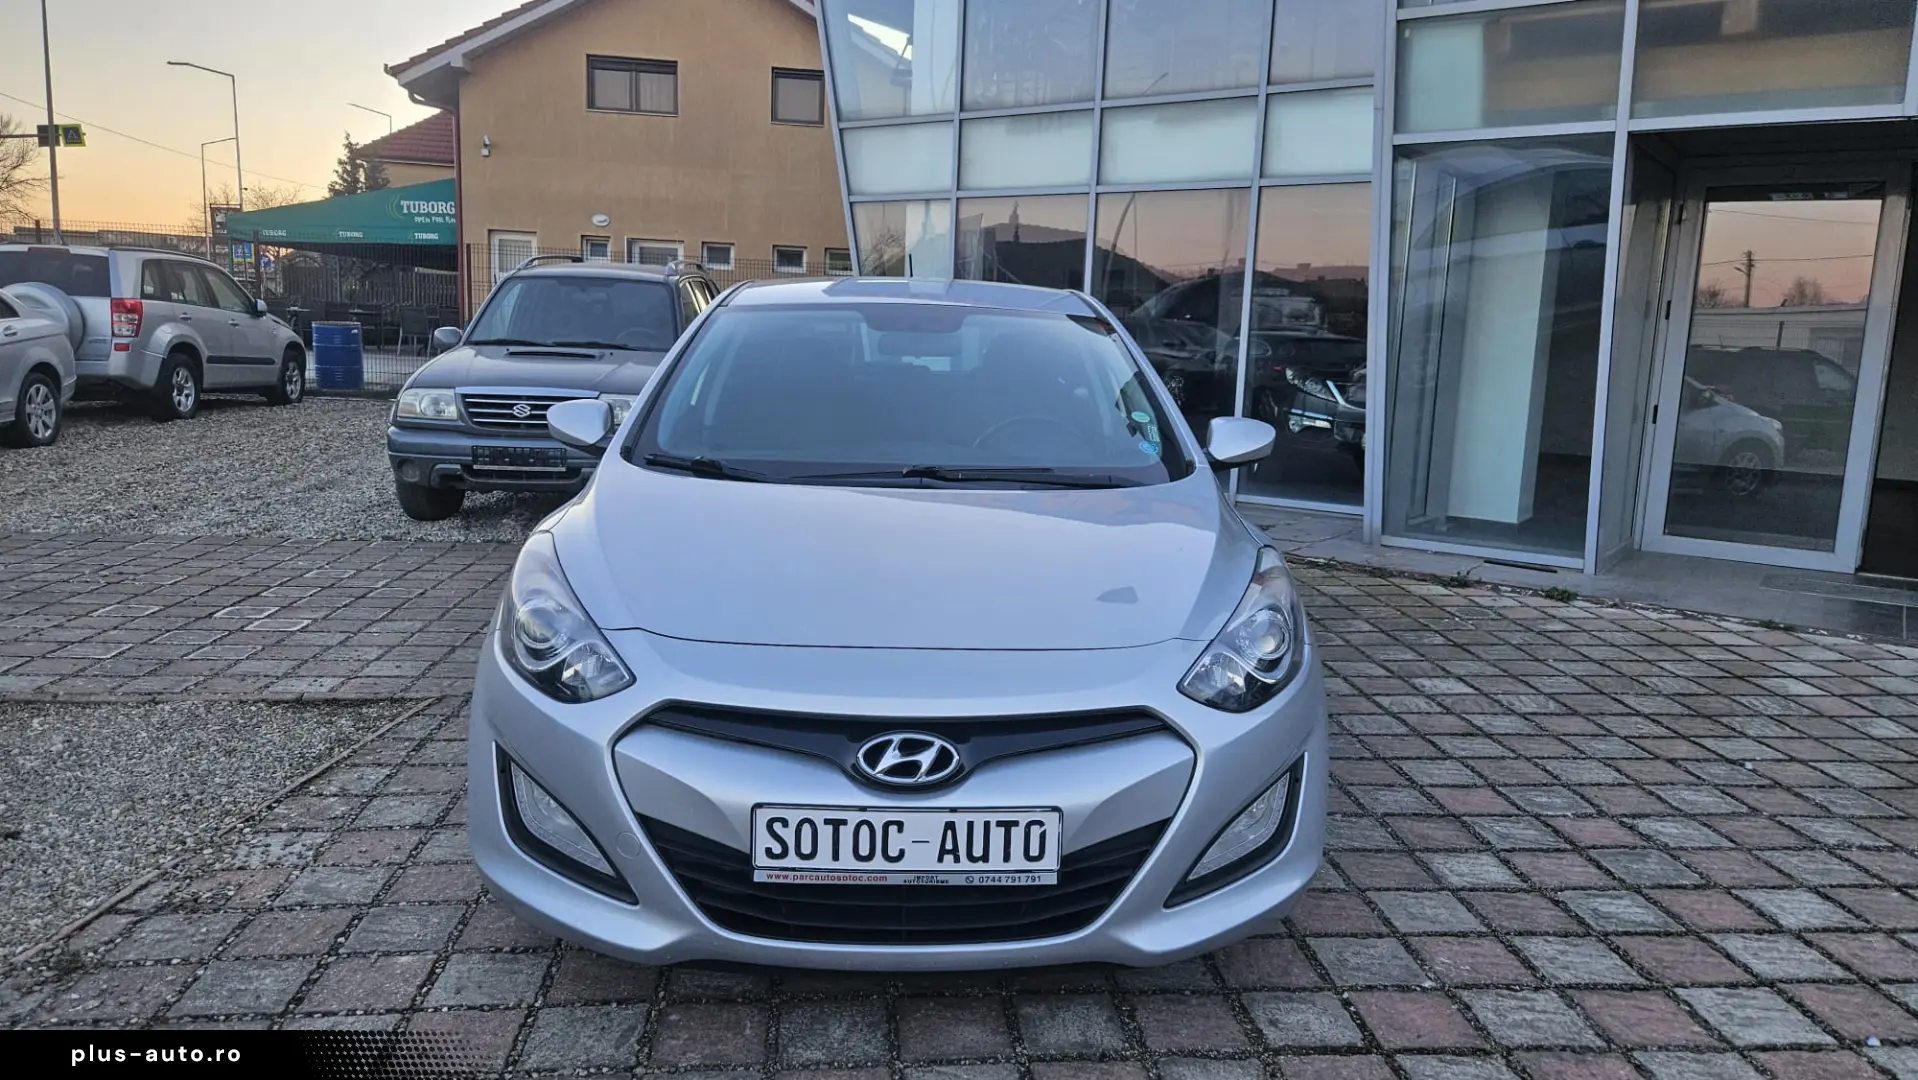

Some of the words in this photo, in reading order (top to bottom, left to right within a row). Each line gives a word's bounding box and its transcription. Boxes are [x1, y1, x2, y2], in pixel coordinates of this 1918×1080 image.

[400, 200, 456, 214] TUBORG
[414, 232, 439, 240] TUBORG
[766, 872, 888, 882] www.parcautosotoc.com
[978, 876, 1002, 884] 0744
